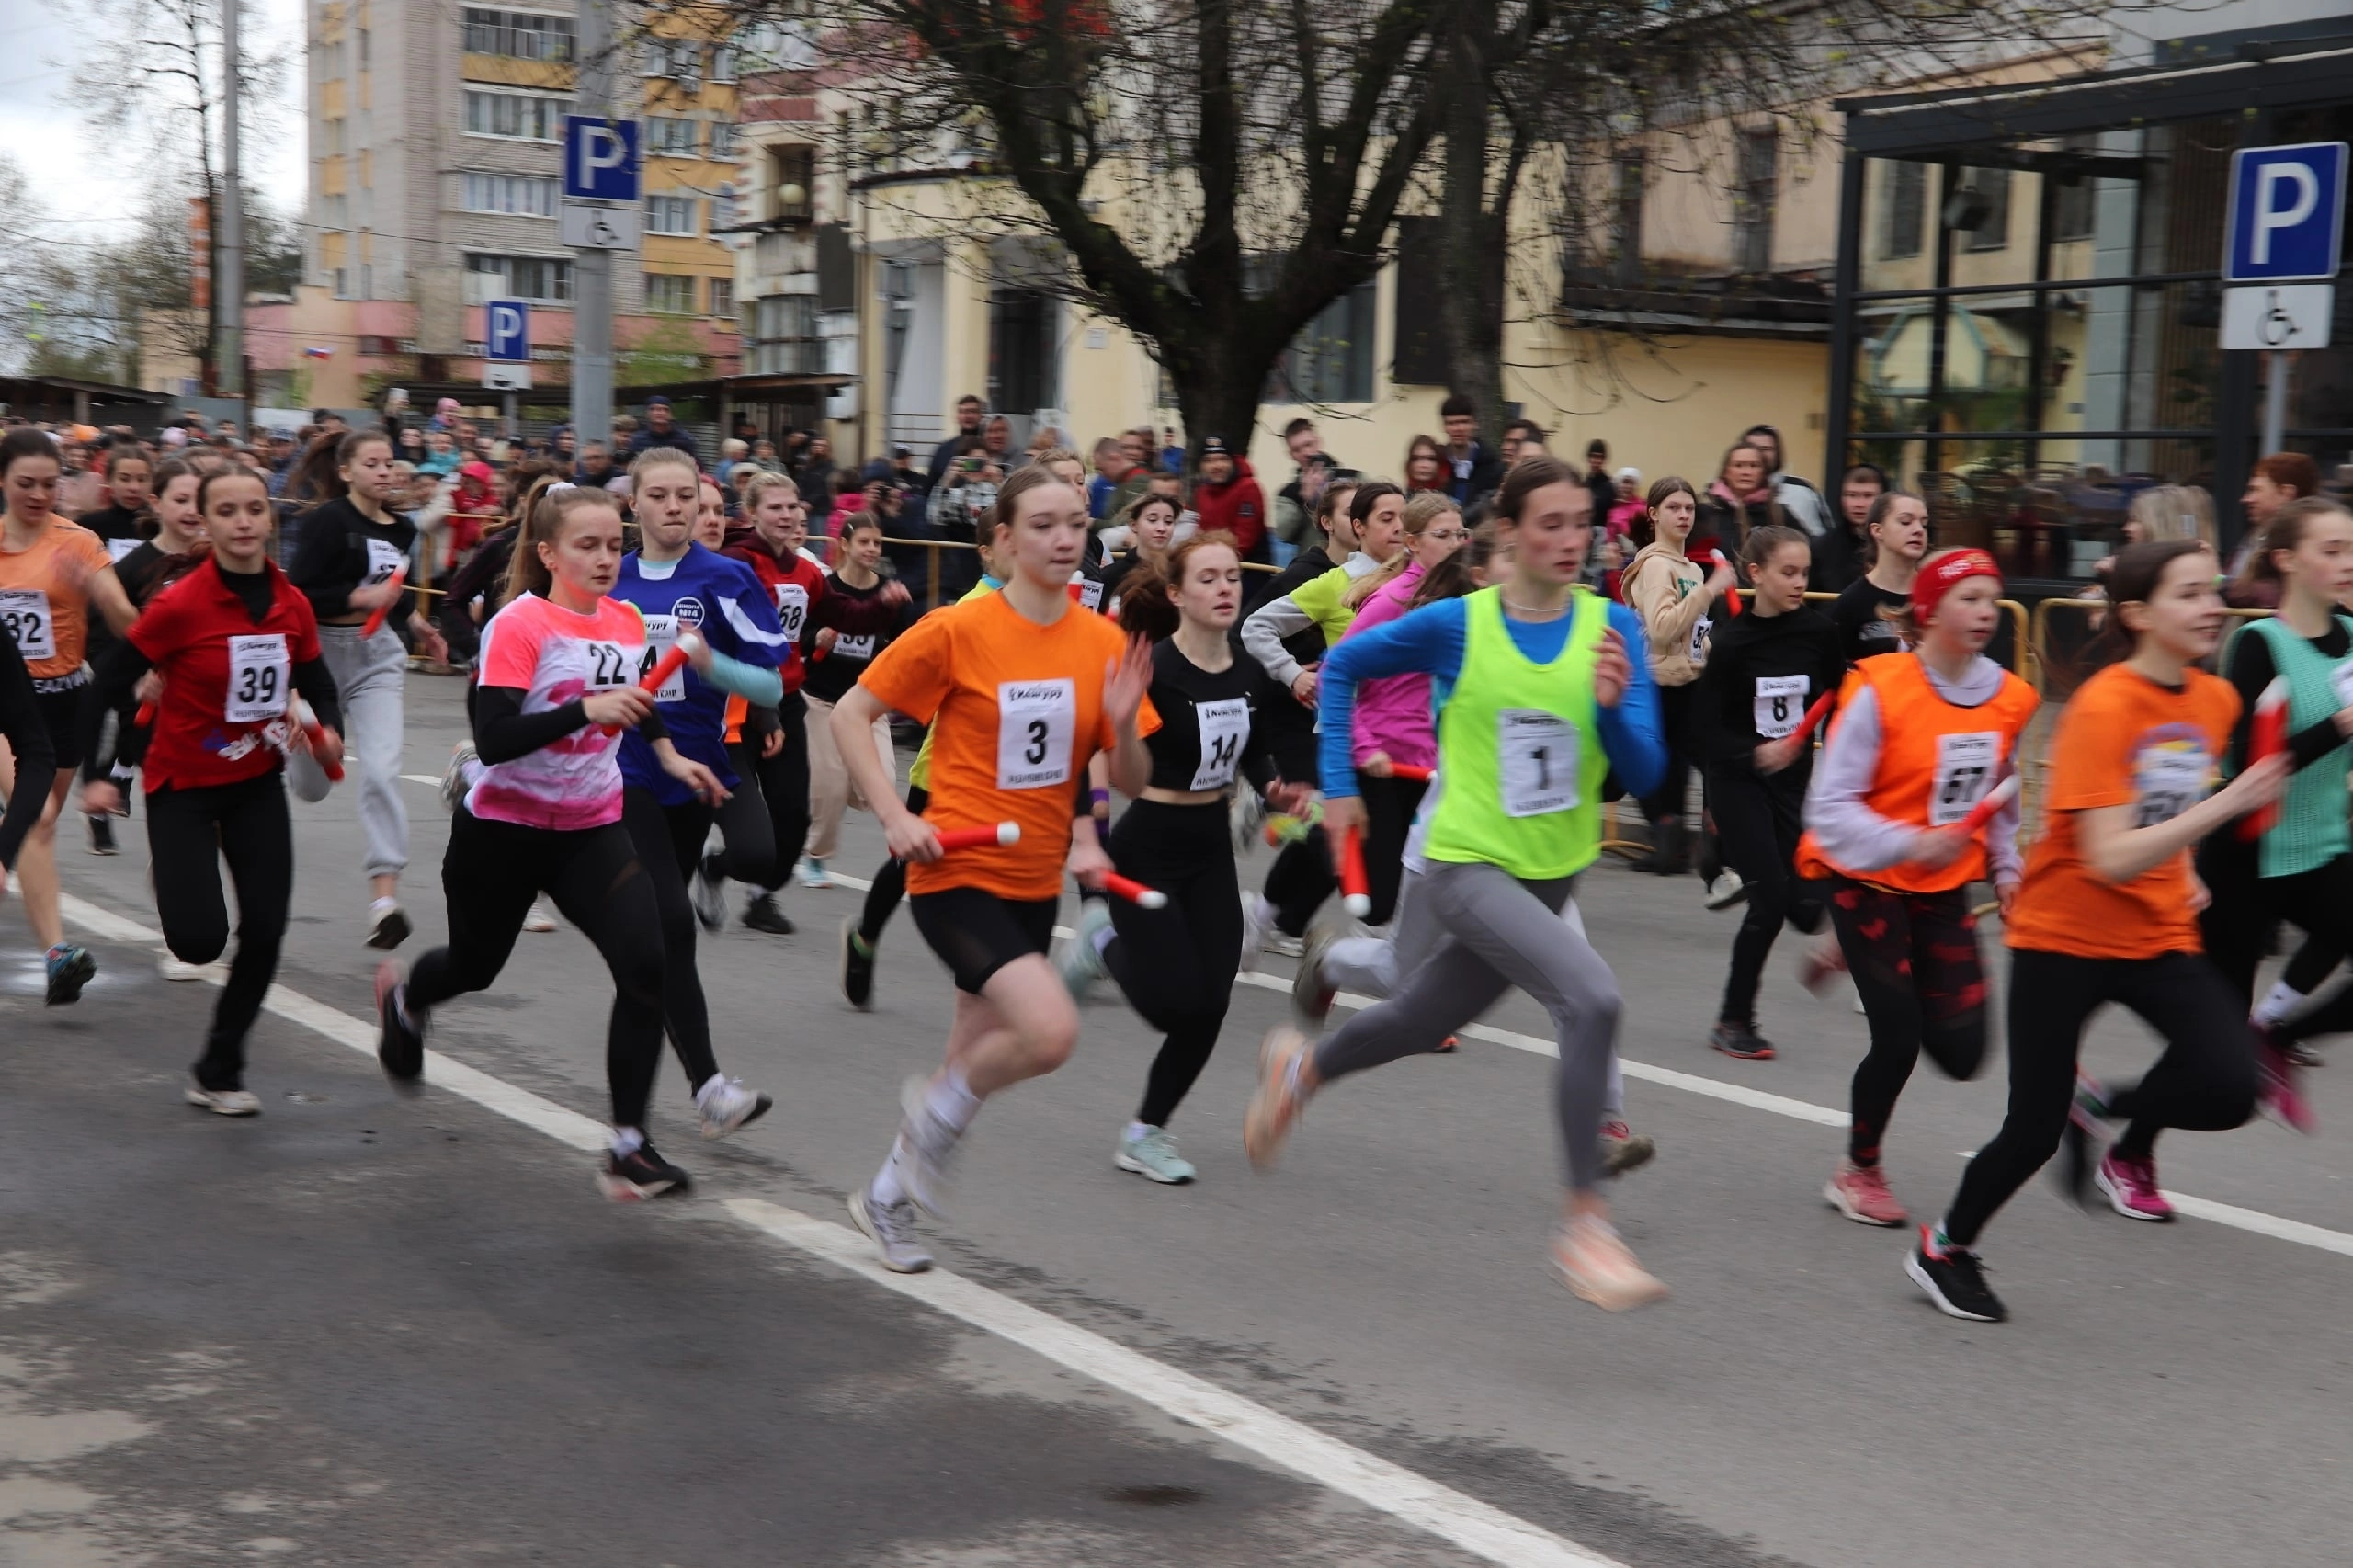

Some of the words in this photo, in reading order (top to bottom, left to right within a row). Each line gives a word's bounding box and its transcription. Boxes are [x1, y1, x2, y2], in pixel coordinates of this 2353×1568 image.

[578, 124, 628, 190] P
[2248, 161, 2319, 265] P
[492, 306, 521, 355] P
[5, 611, 44, 644] 32
[239, 665, 276, 703] 39
[589, 642, 628, 686] 22
[1772, 696, 1789, 722] 8
[1025, 720, 1049, 765] 3
[1210, 733, 1239, 770] 14
[1529, 745, 1550, 790] 1
